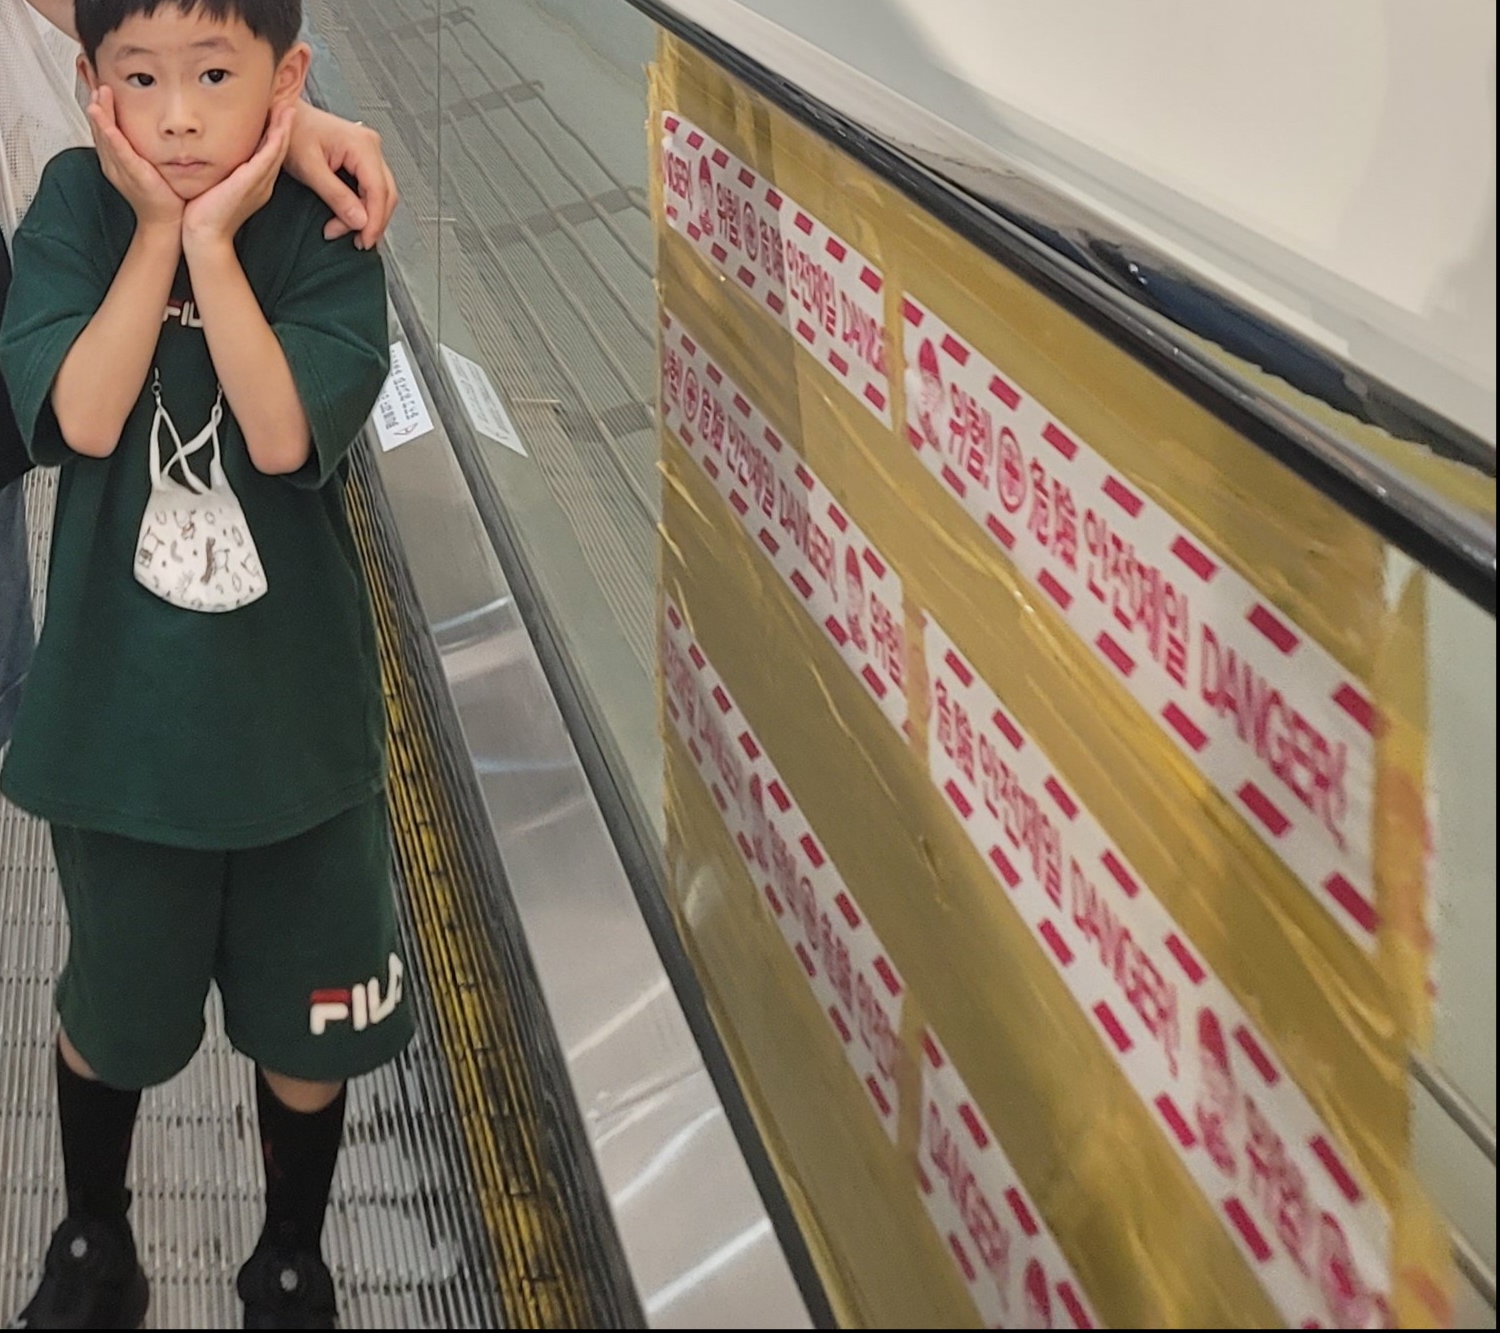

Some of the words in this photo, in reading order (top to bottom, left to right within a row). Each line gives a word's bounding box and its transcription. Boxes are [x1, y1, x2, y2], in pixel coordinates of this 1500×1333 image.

[948, 385, 991, 485] 위험!
[1085, 512, 1187, 685] 안전제일
[1200, 623, 1348, 854] DANGER!
